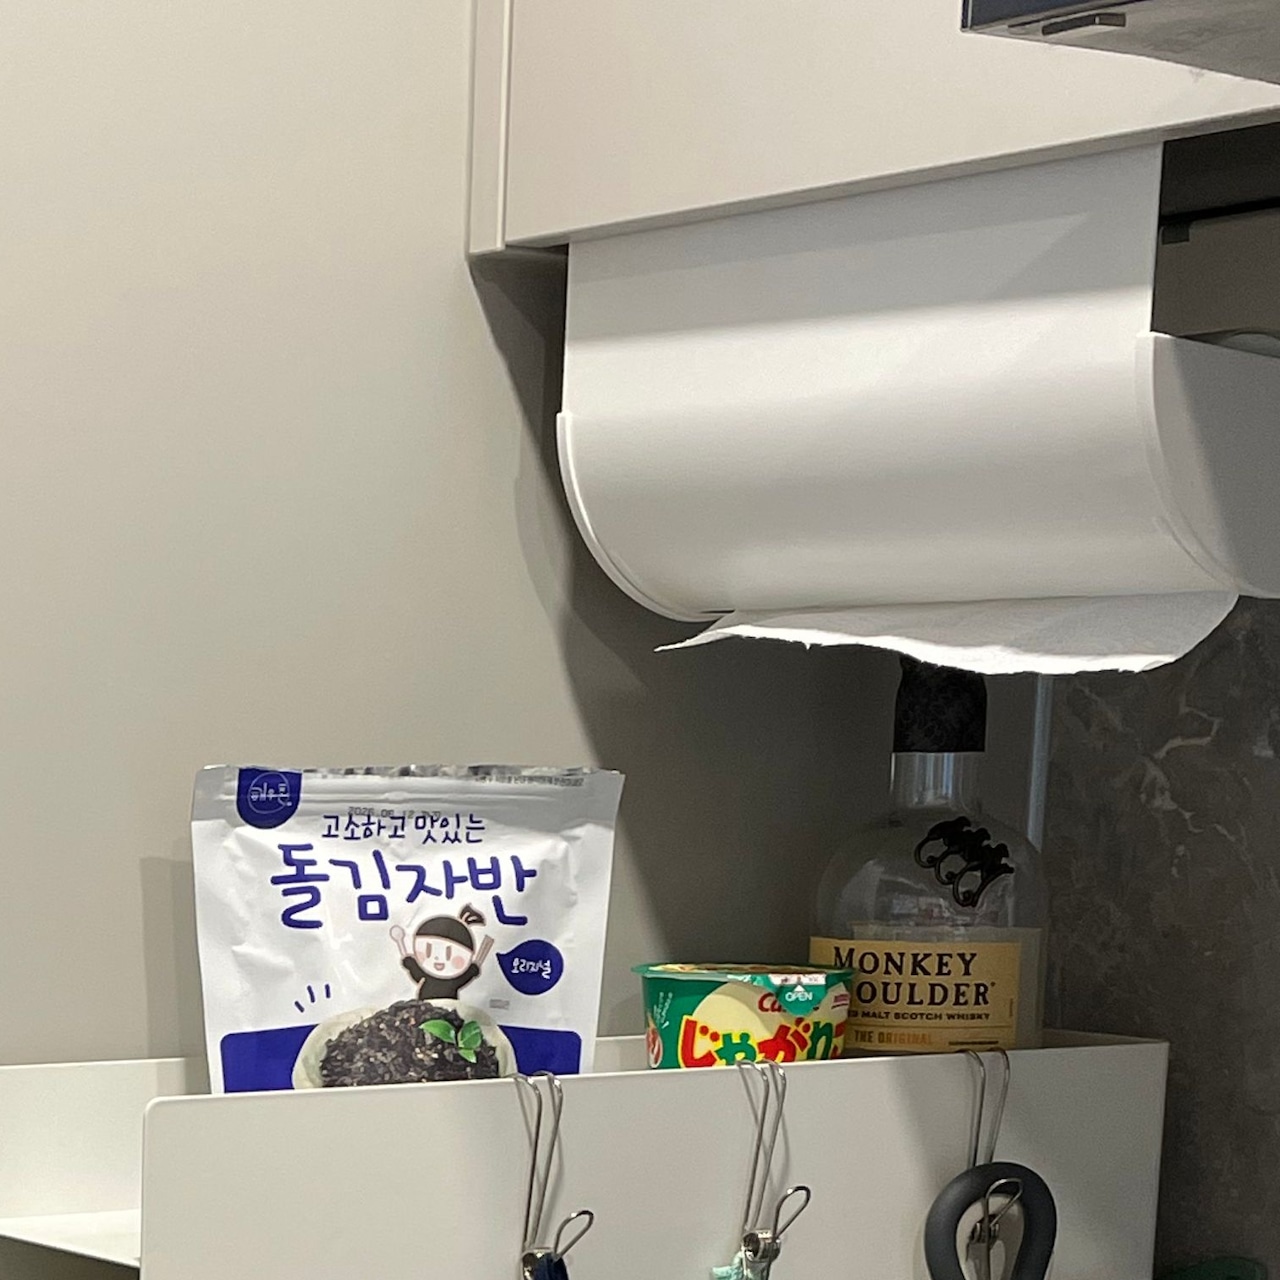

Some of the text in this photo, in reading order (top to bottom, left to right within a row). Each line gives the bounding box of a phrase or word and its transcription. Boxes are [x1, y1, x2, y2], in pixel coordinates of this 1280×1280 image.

[321, 813, 486, 844] 고소하고 맛있는
[270, 842, 538, 929] 돌김자반
[511, 957, 551, 980] 오리지널
[833, 946, 978, 976] MONKEY
[785, 991, 813, 1002] OPEN
[856, 981, 990, 1006] OULDER
[861, 1010, 891, 1020] MALT
[894, 1012, 943, 1021] SCOTCH
[946, 1012, 990, 1021] WHISKY
[854, 1030, 933, 1046] THE ORIGINAL
